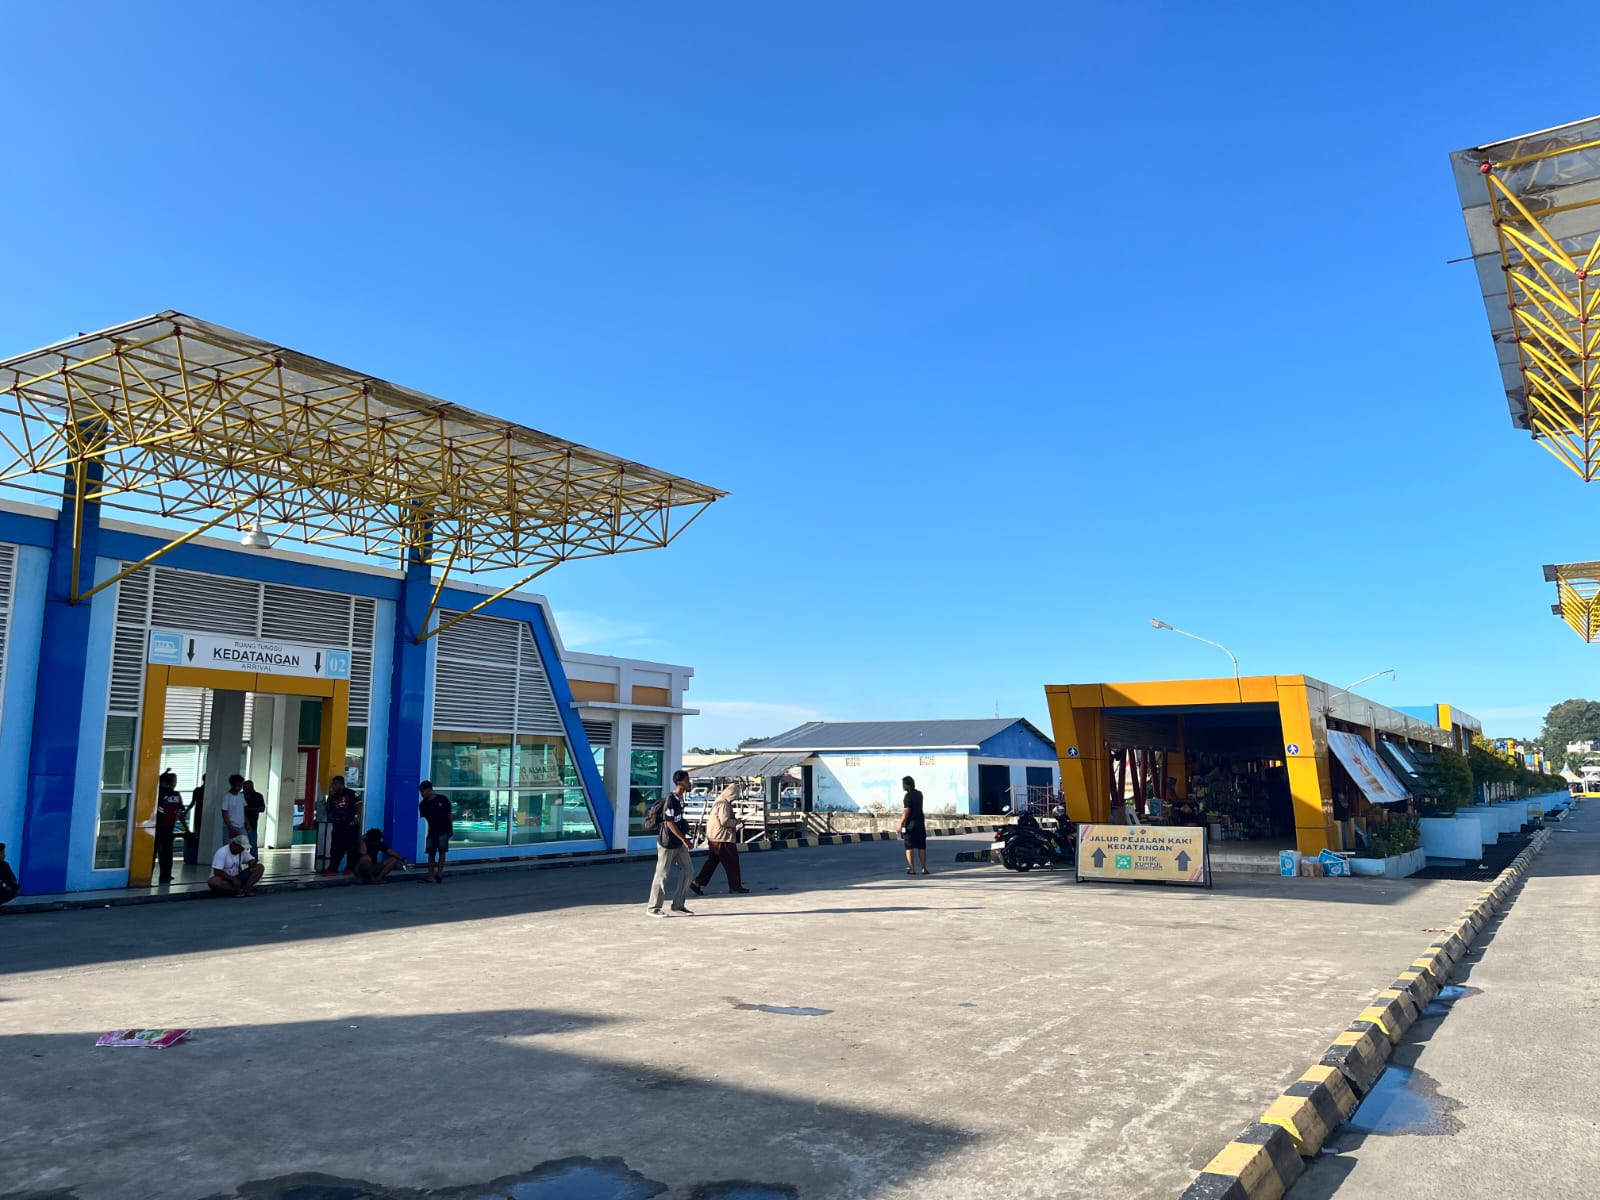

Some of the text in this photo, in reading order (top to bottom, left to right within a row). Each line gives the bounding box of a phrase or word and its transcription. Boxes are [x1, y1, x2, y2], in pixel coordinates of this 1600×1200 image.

[234, 641, 283, 652] RUANG TUNGGU
[213, 647, 300, 666] KEDATANGAN
[241, 663, 272, 672] ARRIVAL
[329, 657, 346, 673] 02
[1122, 836, 1165, 844] PEJALAN
[1167, 837, 1192, 845] KAKI
[1107, 843, 1173, 852] KEDATANGAN
